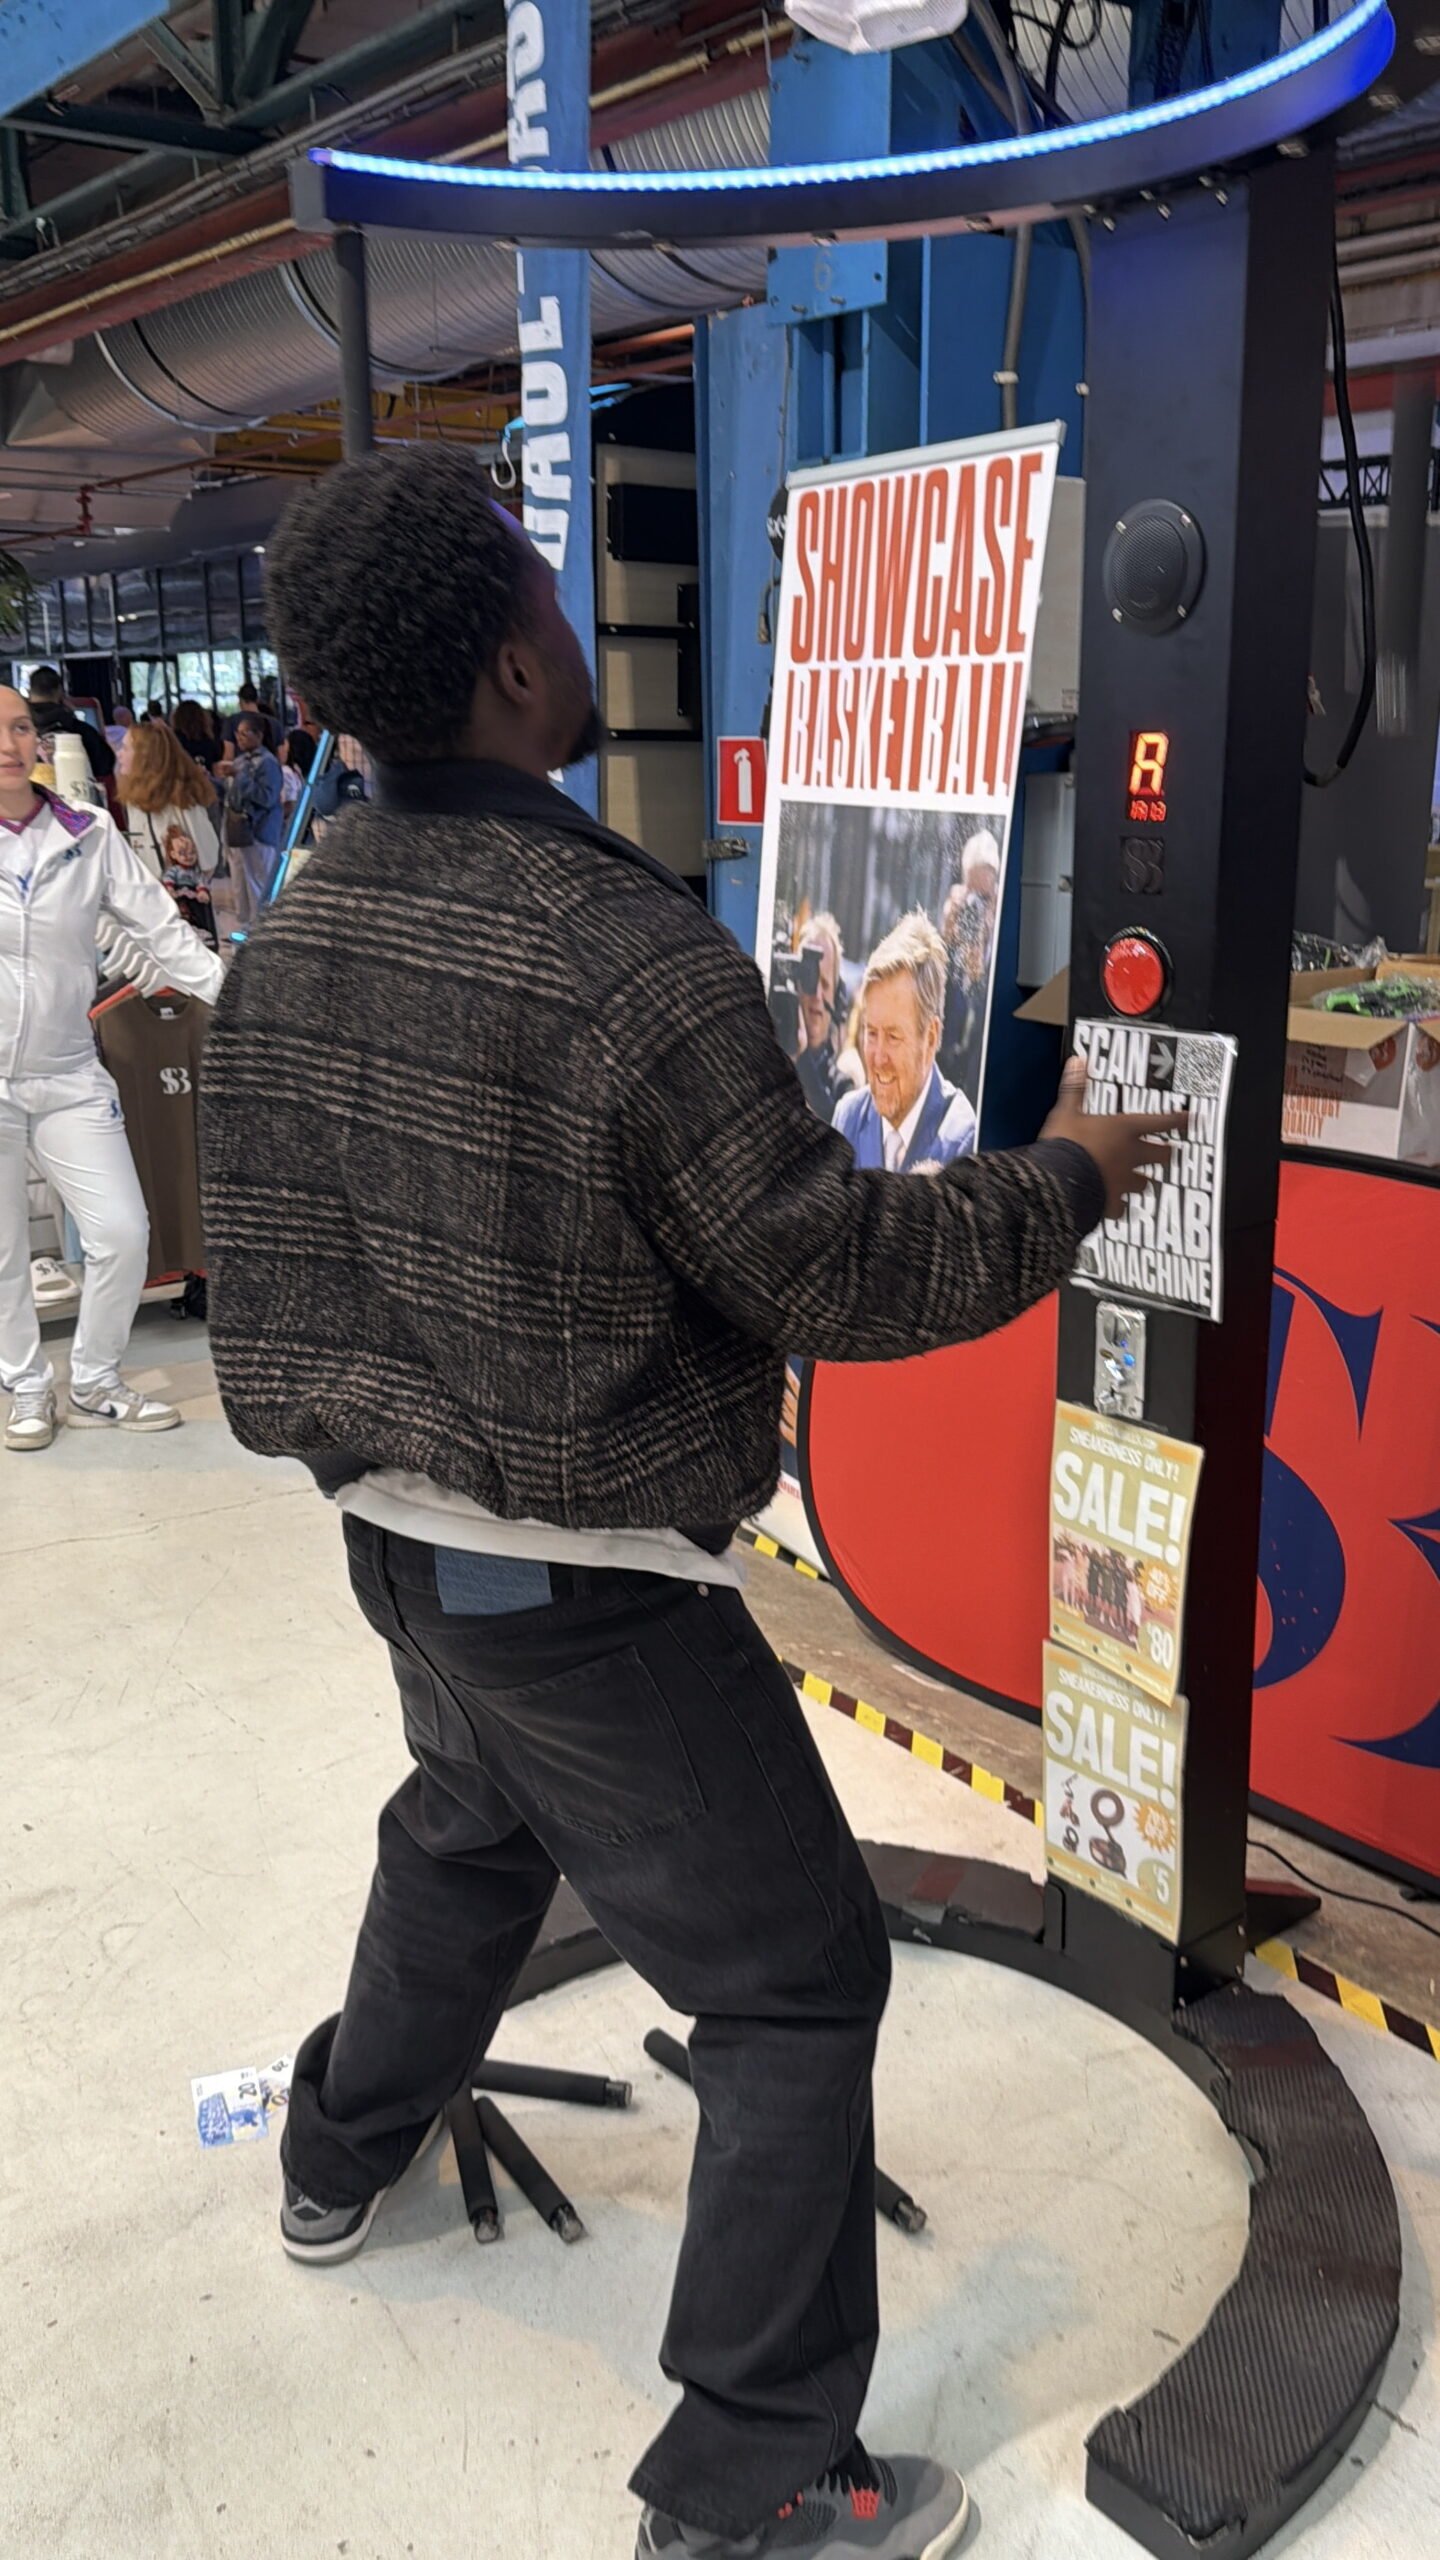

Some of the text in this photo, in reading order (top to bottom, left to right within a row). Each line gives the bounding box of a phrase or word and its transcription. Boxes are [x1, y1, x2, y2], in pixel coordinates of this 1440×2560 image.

[790, 452, 1043, 664] SHOWCASE
[786, 662, 1020, 797] BASKETBALL
[1073, 1024, 1150, 1087] SCAN
[1167, 1138, 1214, 1193] THE
[1187, 1096, 1217, 1146] IN
[1106, 1239, 1212, 1308] MACHINE
[1053, 1450, 1188, 1567] SALE!
[1046, 1690, 1177, 1810] SALE!
